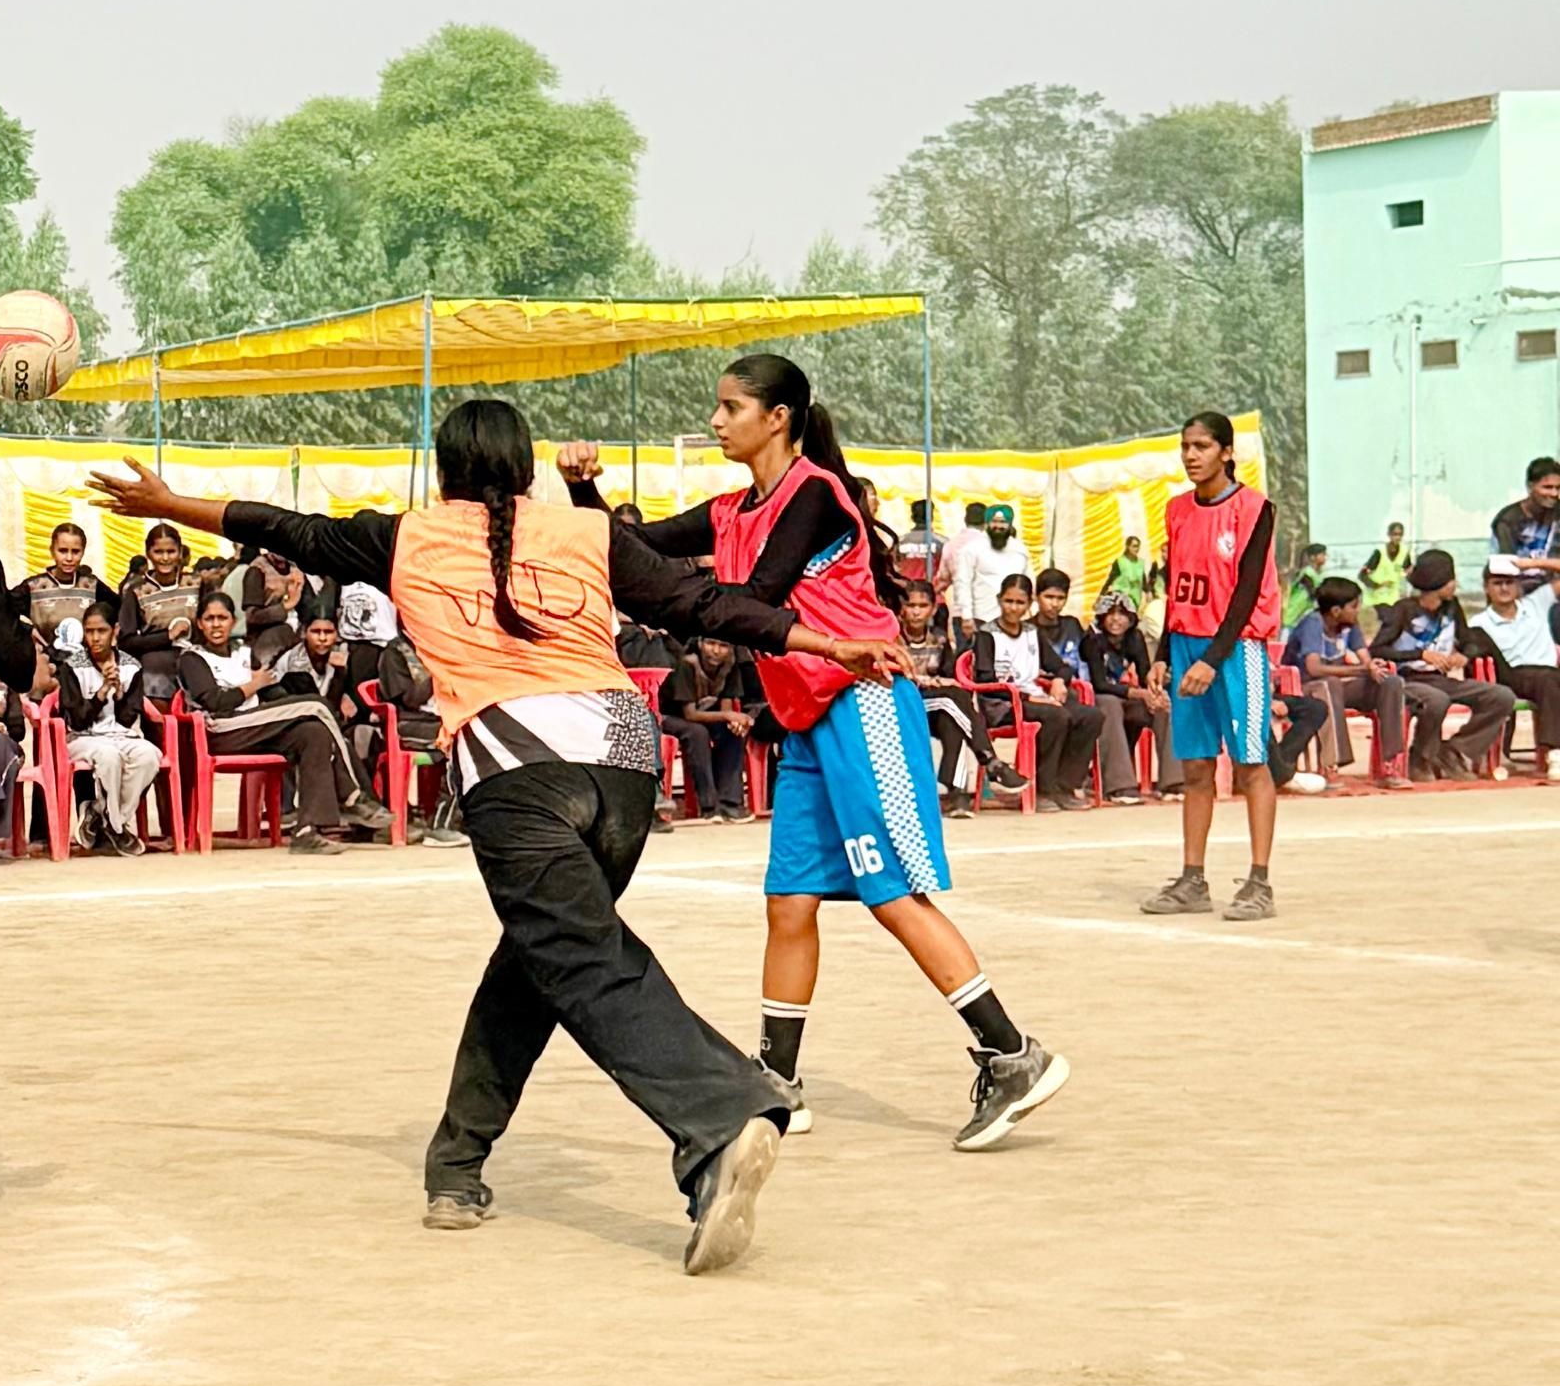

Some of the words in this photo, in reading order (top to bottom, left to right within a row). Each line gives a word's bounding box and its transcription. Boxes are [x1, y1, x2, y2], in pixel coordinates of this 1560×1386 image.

[14, 359, 29, 402] OSCO
[1175, 571, 1210, 606] GD
[844, 834, 885, 878] 06
